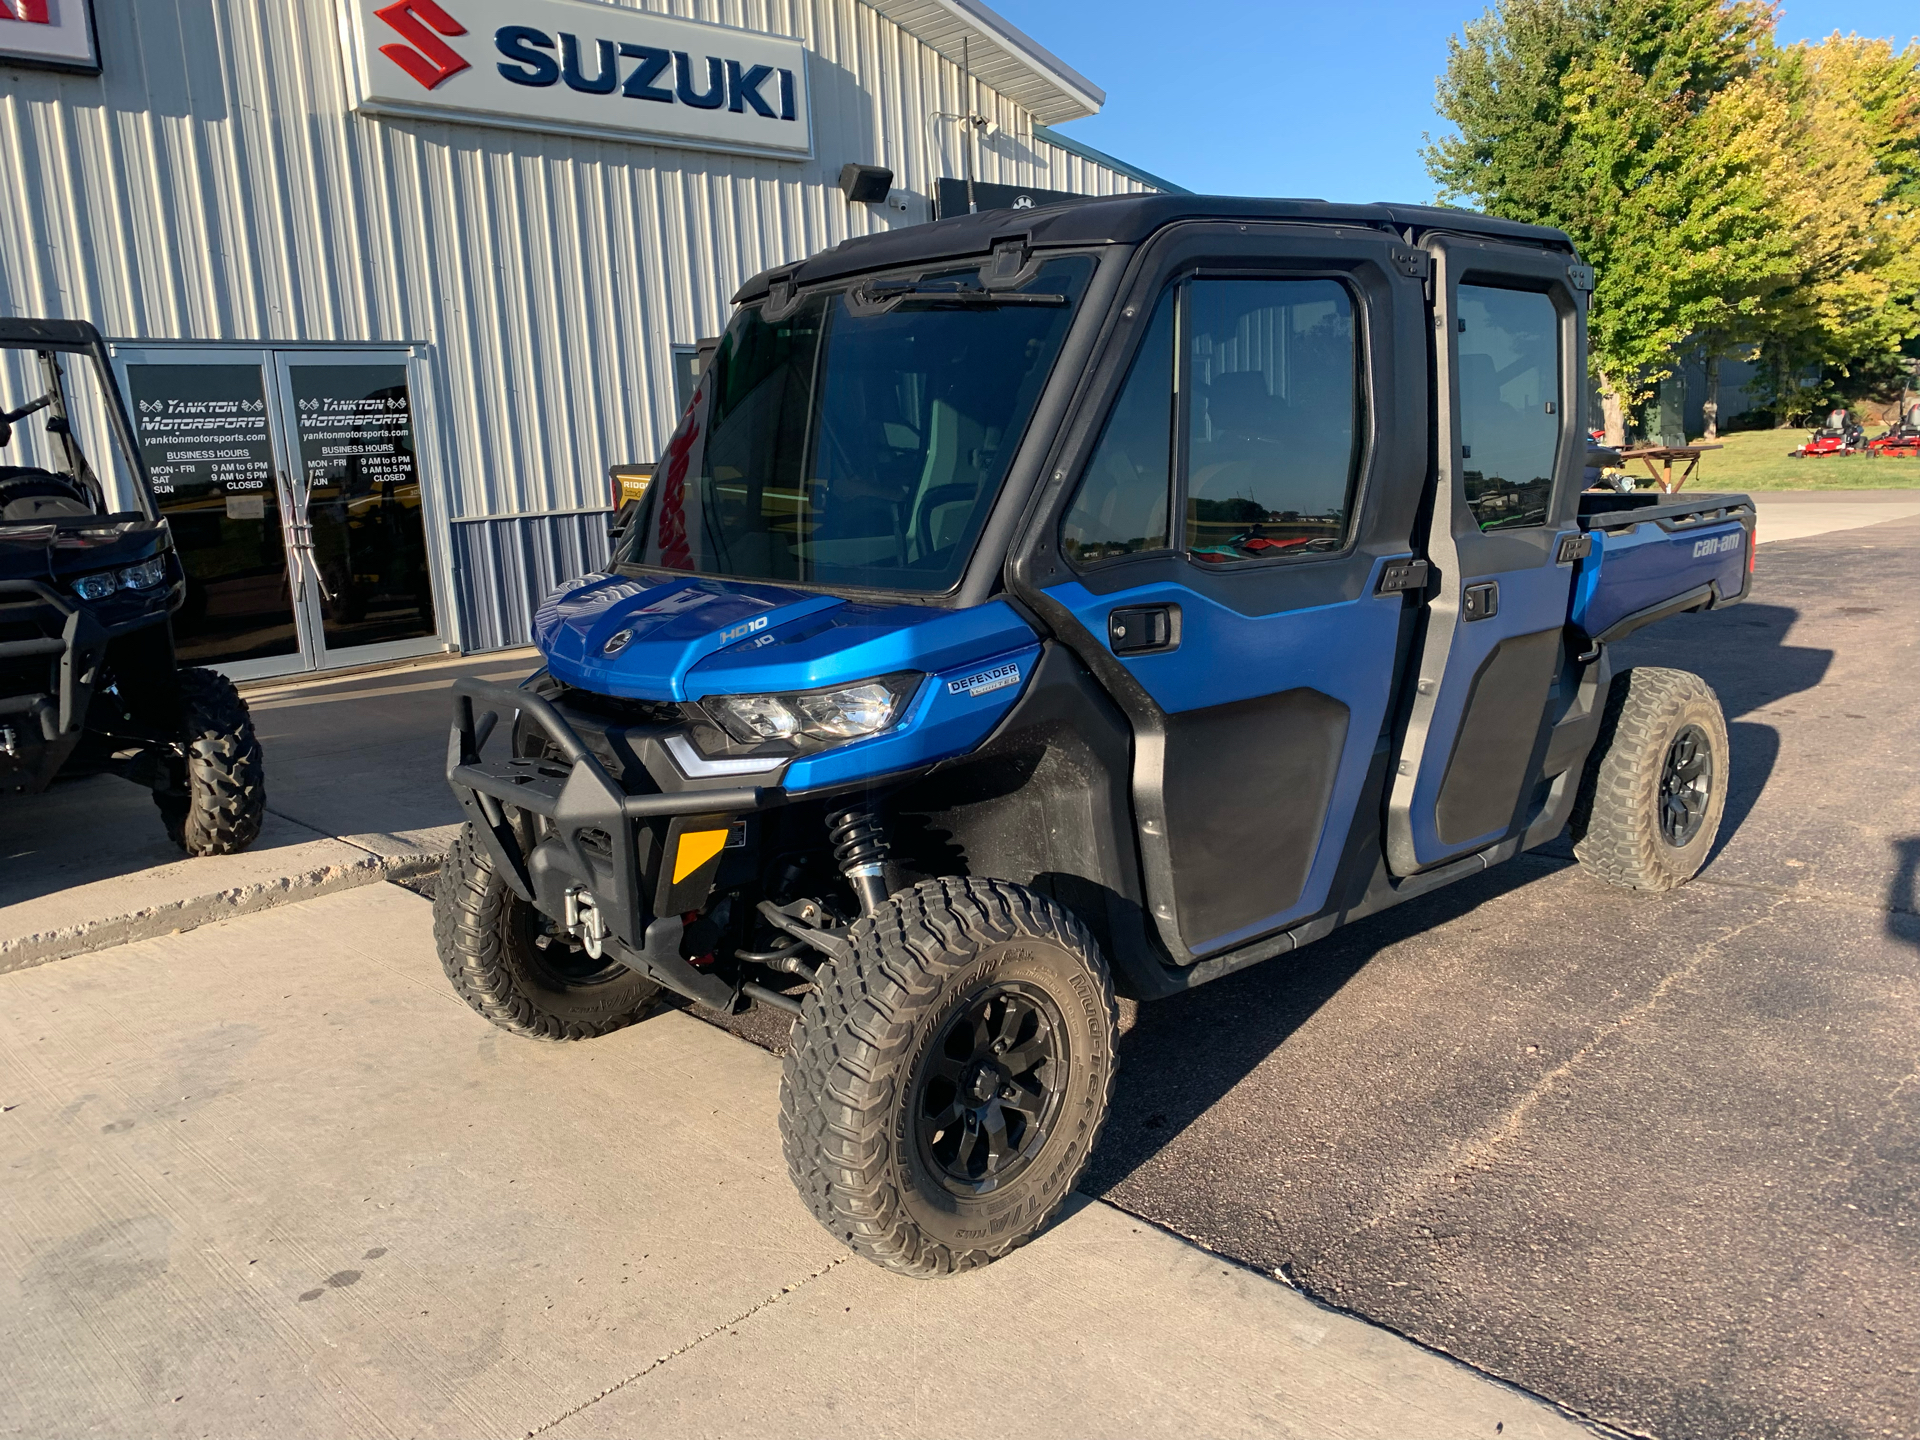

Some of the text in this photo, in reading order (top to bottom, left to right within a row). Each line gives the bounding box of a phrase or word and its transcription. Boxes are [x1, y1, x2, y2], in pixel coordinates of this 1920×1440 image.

[494, 25, 796, 121] SUZUKI
[145, 434, 266, 446] yanktonmotorsports.com
[303, 430, 409, 442] yanktonmotorsports.com
[167, 449, 250, 459] BUSINESS HOURS
[322, 444, 395, 454] BUSINESS HOURS
[308, 460, 328, 468] MON
[333, 459, 347, 467] FRI
[368, 457, 380, 465] AM
[151, 466, 173, 474] MON
[180, 465, 196, 473] FRI
[211, 464, 218, 472] 9
[220, 463, 234, 471] AM
[236, 463, 245, 471] to
[255, 462, 268, 470] PM
[362, 466, 368, 474] 9
[383, 465, 391, 473] to
[152, 476, 170, 484] SAT
[211, 473, 218, 481] 9
[220, 472, 234, 480] AM
[236, 472, 245, 480] to
[255, 471, 268, 479] PM
[373, 473, 406, 482] CLOSED
[153, 485, 174, 494] SUN
[226, 481, 263, 489] CLOSED
[623, 481, 649, 489] RIDG
[1693, 533, 1740, 558] can-am
[720, 616, 768, 645] HD10
[951, 663, 1018, 691] DEFENDER
[1041, 972, 1104, 1196] Mud-Terrain
[989, 1194, 1042, 1235] T/A
